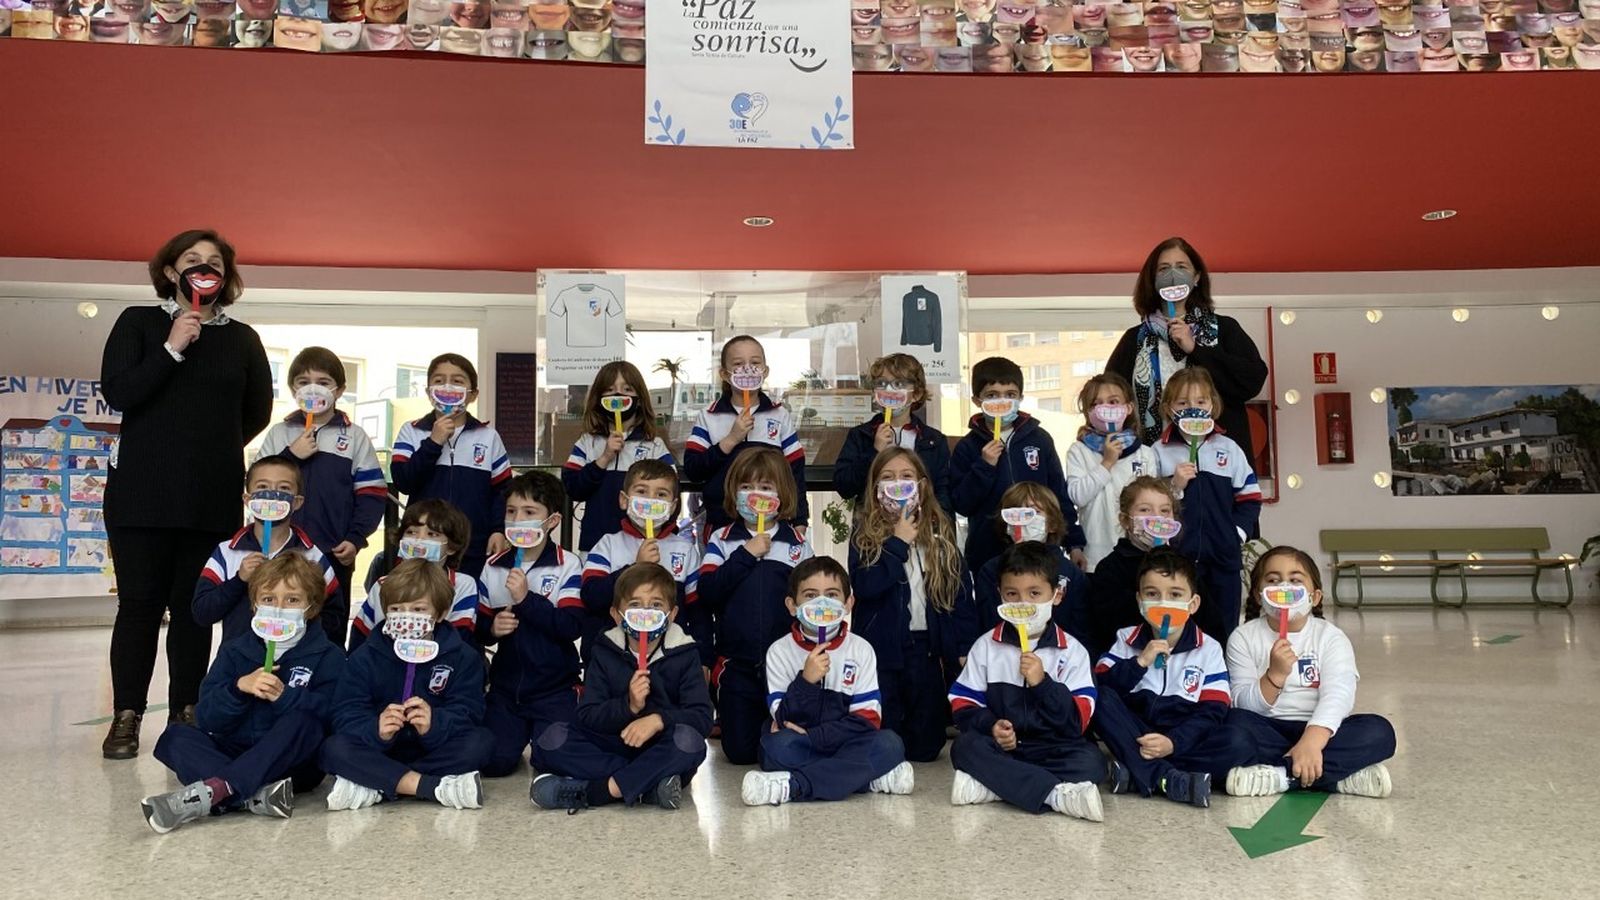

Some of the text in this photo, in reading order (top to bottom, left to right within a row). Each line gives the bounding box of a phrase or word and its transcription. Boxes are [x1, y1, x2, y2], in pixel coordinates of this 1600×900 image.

[693, 19, 762, 31] comienza
[729, 119, 748, 129] 30E
[57, 398, 87, 415] JE
